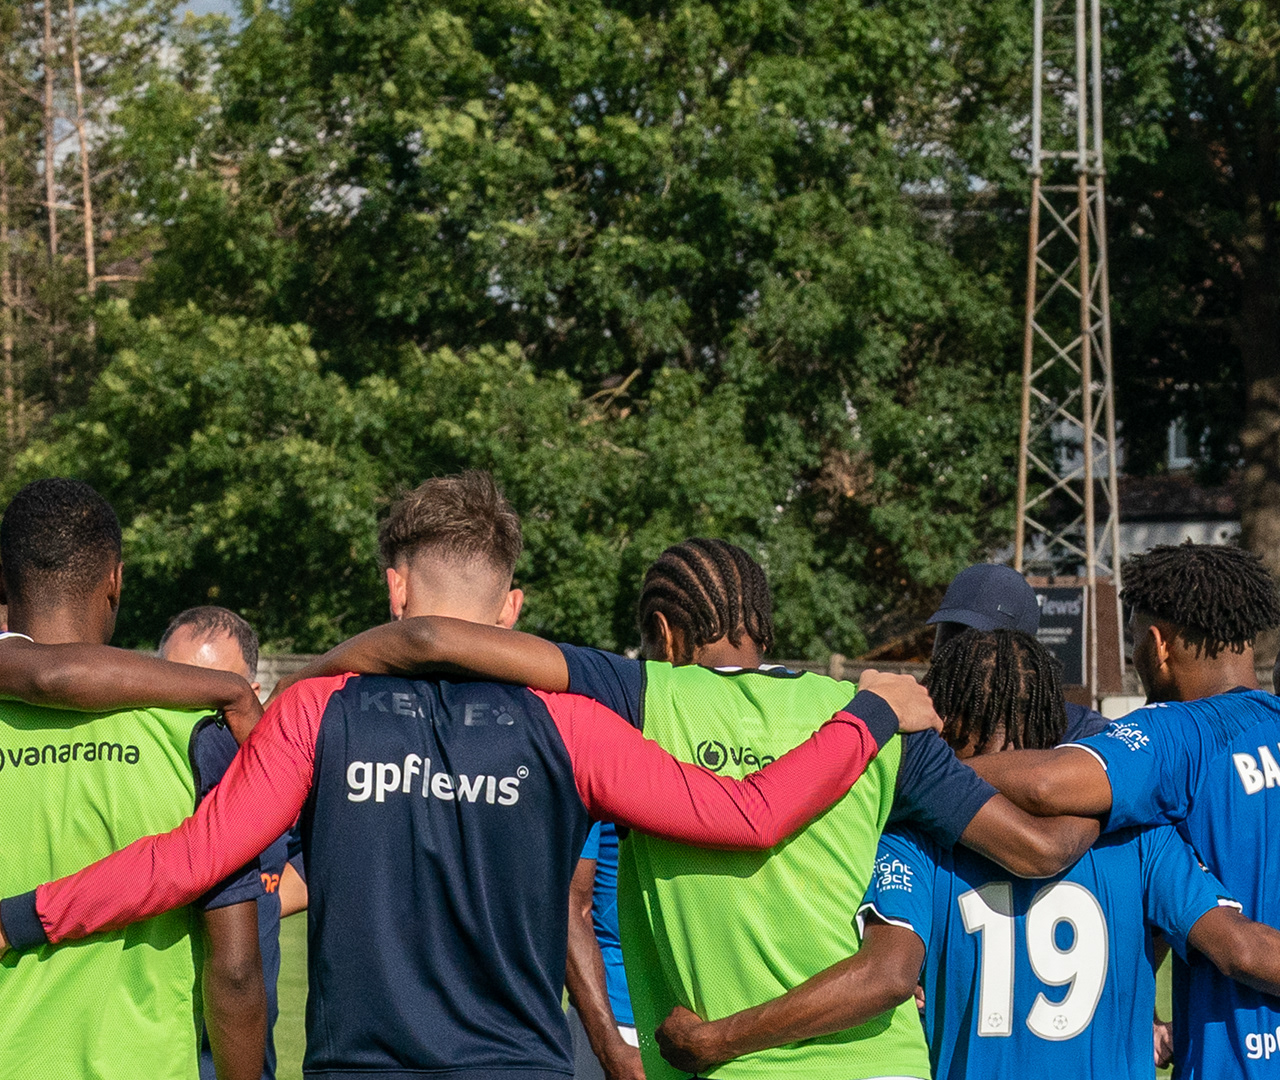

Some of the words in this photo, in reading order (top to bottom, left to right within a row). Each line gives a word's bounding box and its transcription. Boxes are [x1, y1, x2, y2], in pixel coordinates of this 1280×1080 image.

[8, 741, 141, 768] vanarama
[346, 753, 522, 806] gpflewis
[958, 880, 1110, 1041] 19
